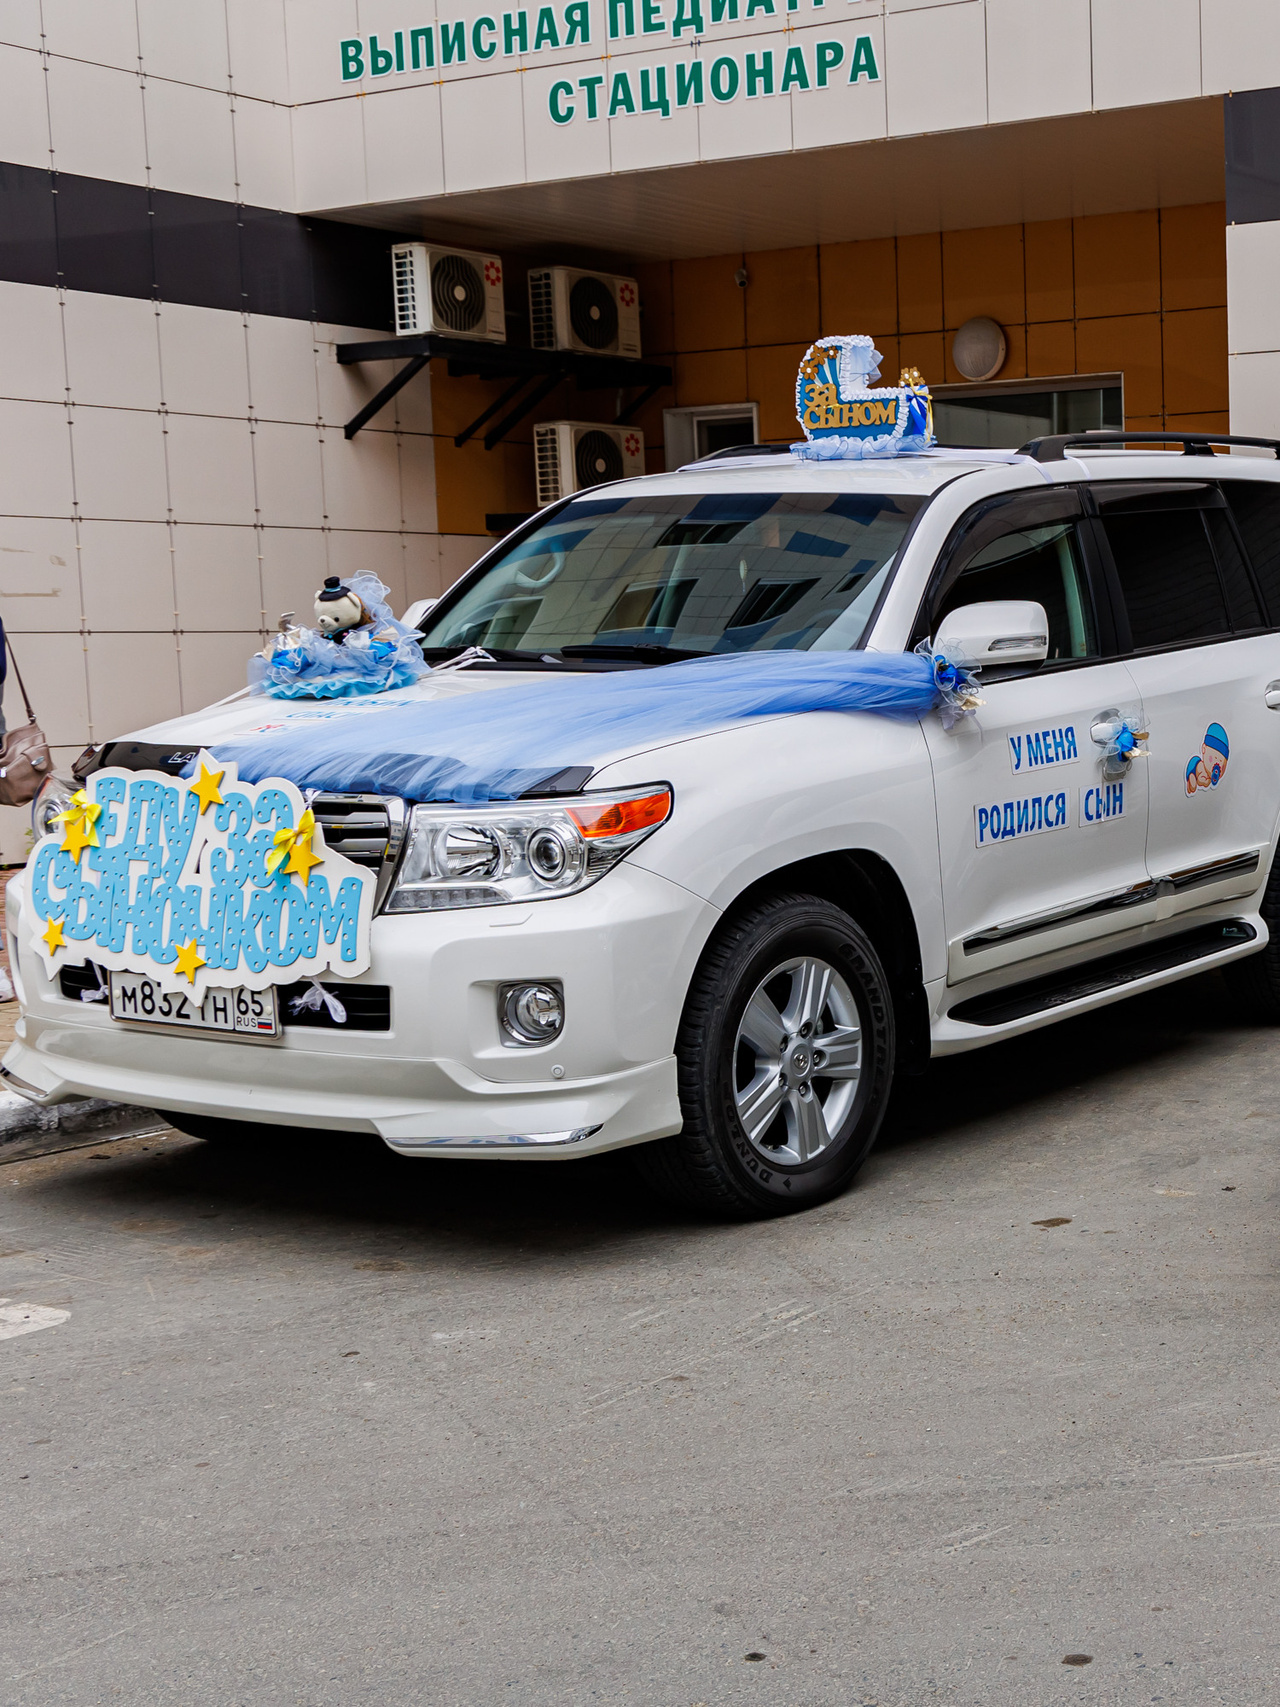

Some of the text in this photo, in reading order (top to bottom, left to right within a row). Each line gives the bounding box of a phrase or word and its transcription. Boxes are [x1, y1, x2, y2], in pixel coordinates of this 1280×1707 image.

[340, 0, 826, 82] ВЫПИСНАЯ ПЕДИ
[548, 36, 879, 123] СТАЦИОНАРА
[1009, 726, 1078, 770] У МЕНЯ
[90, 777, 200, 885] ЕДУ
[978, 783, 1124, 842] РОДИЛСЯ СЫН
[32, 844, 364, 973] СЫНОЧКОМ
[236, 988, 264, 1017] 65
[236, 1016, 257, 1028] RUS
